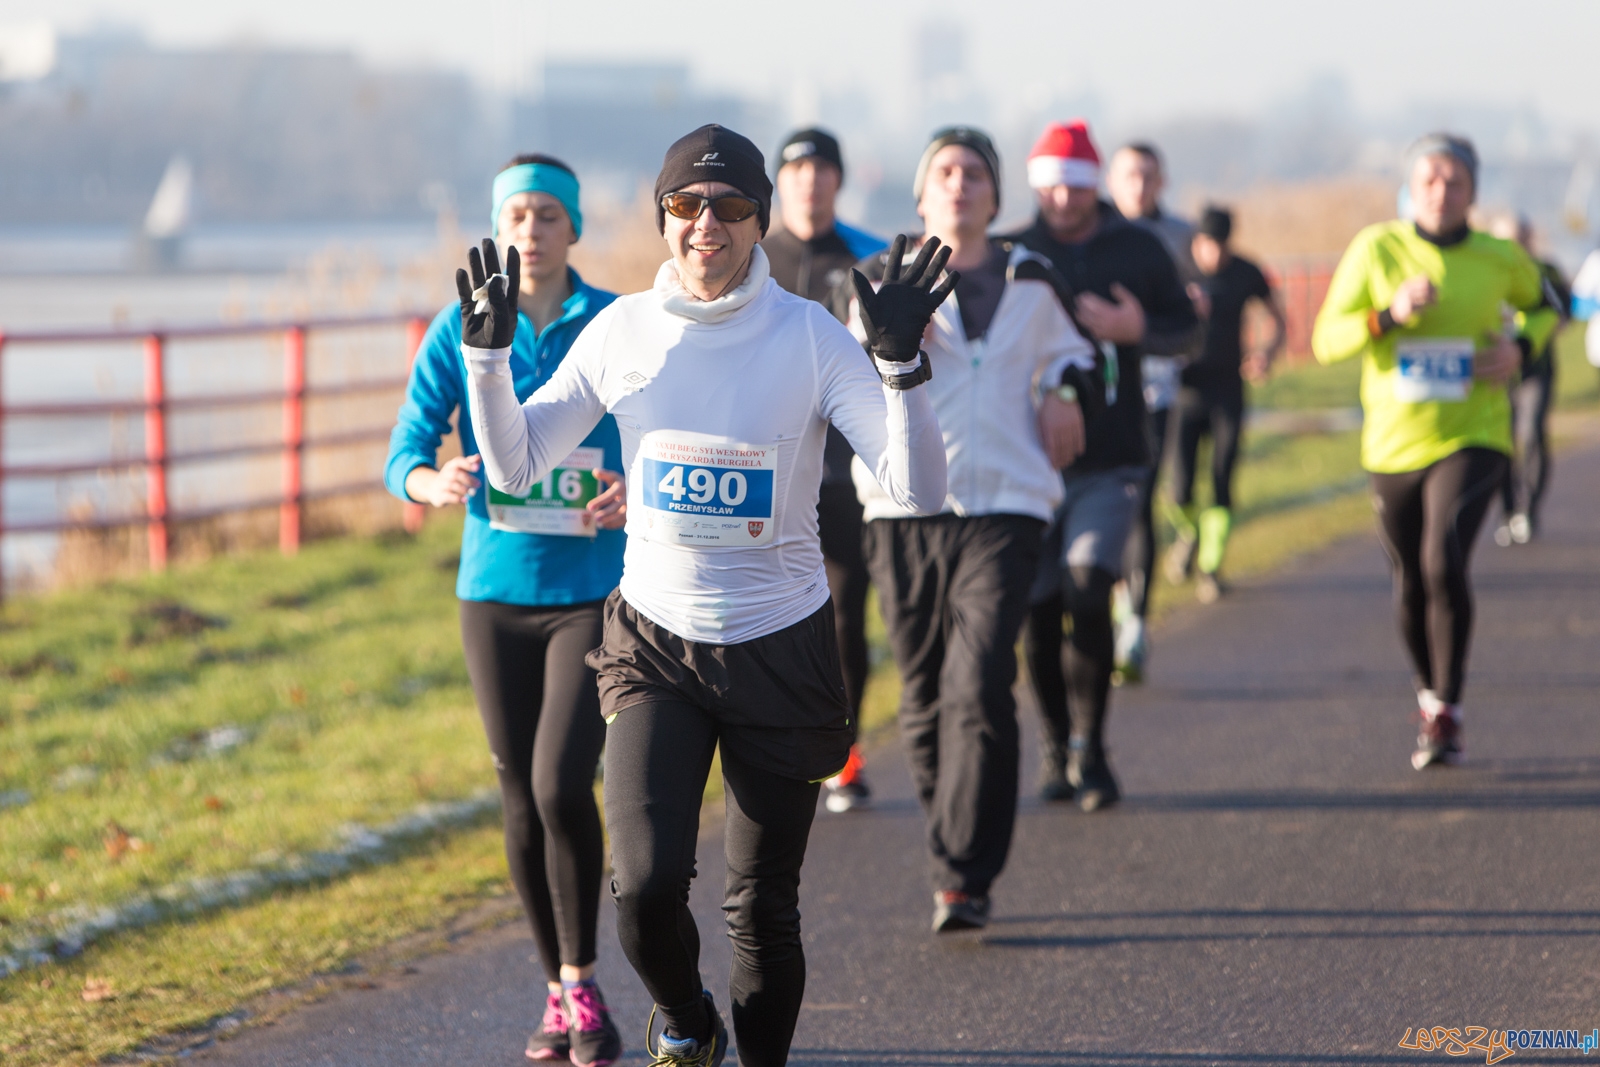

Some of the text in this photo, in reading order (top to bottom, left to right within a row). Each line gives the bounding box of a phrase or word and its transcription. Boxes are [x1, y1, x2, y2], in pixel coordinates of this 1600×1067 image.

[677, 444, 698, 453] BIEG
[699, 446, 767, 458] SYLWESTROWY
[670, 453, 715, 465] RYSZARDA
[717, 459, 762, 467] BURGIELA
[658, 465, 748, 506] 490
[668, 502, 734, 515] PRZEMYSŁAW
